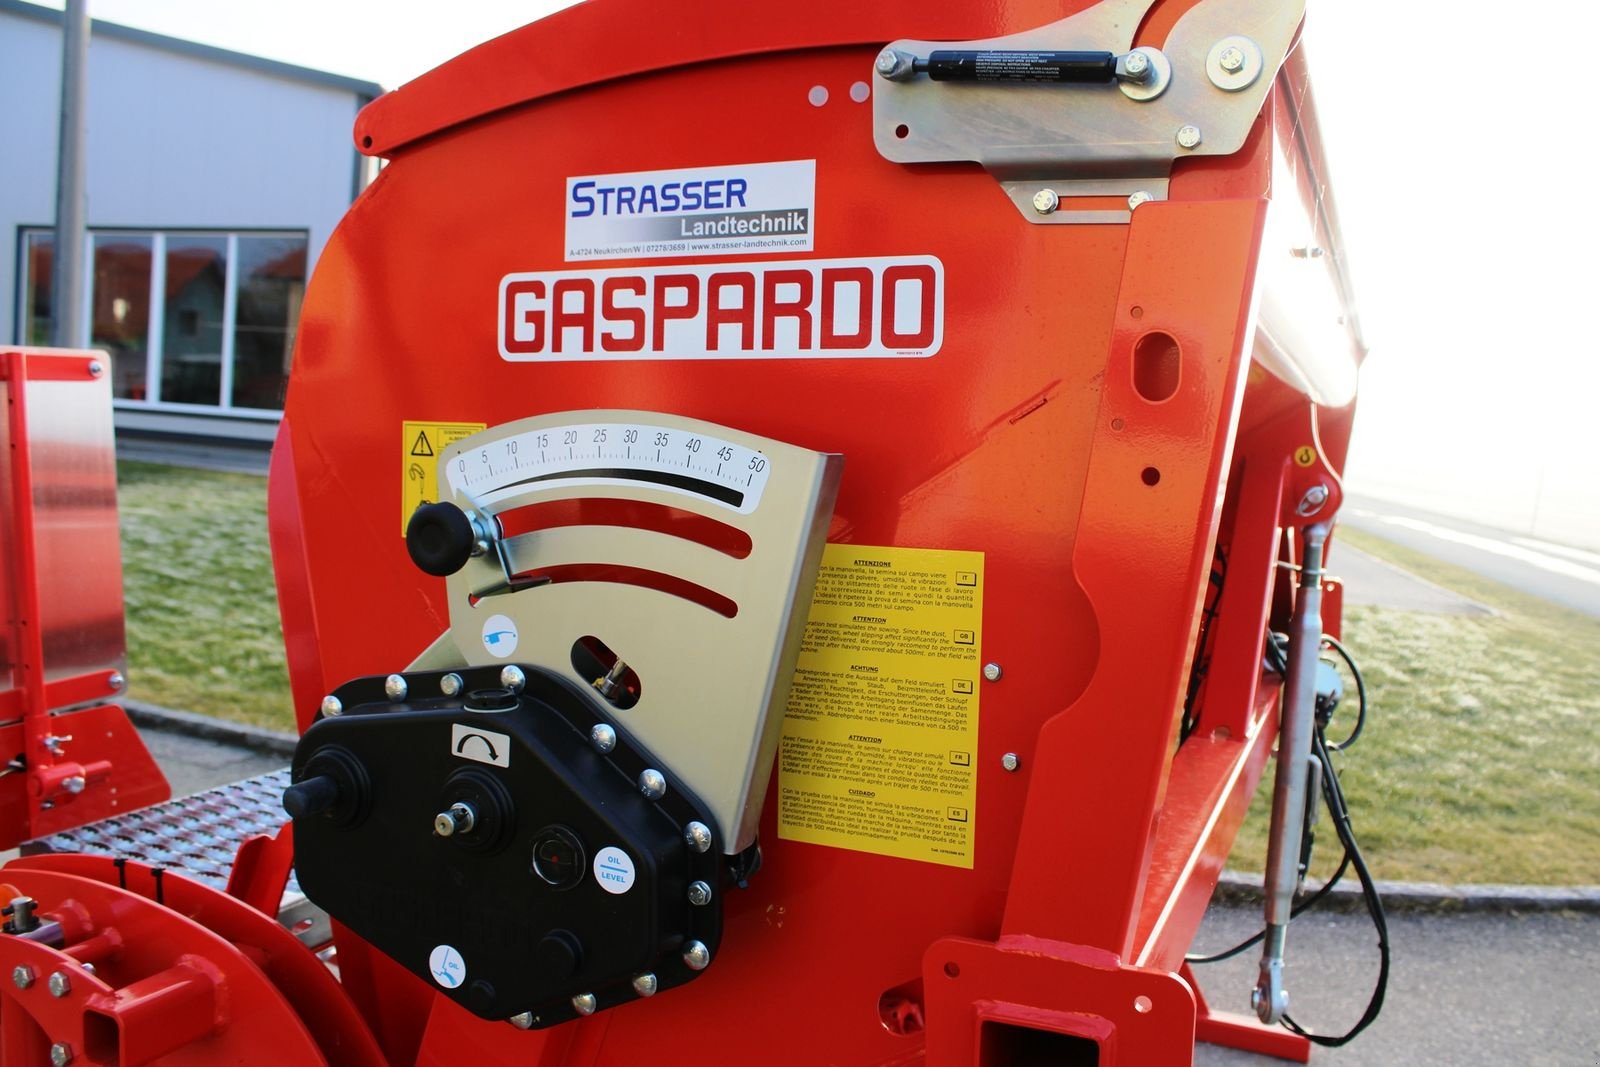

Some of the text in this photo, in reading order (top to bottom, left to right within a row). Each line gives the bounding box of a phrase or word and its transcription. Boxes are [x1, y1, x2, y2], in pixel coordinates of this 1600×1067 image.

[572, 178, 746, 218] STRASSER
[681, 212, 805, 237] Landtechnik
[570, 248, 592, 256] A-4724
[594, 246, 641, 256] Neukirchen/W
[692, 238, 807, 250] www.strasser-landtechnik.com
[505, 265, 936, 354] GASPARDO
[459, 429, 765, 472] 0 5 10 15 20 25 30 35 40 45 50
[848, 734, 882, 743] ATTENTION
[848, 789, 875, 797] CUIDADO
[608, 856, 621, 864] OIL
[601, 872, 626, 883] LEVEL
